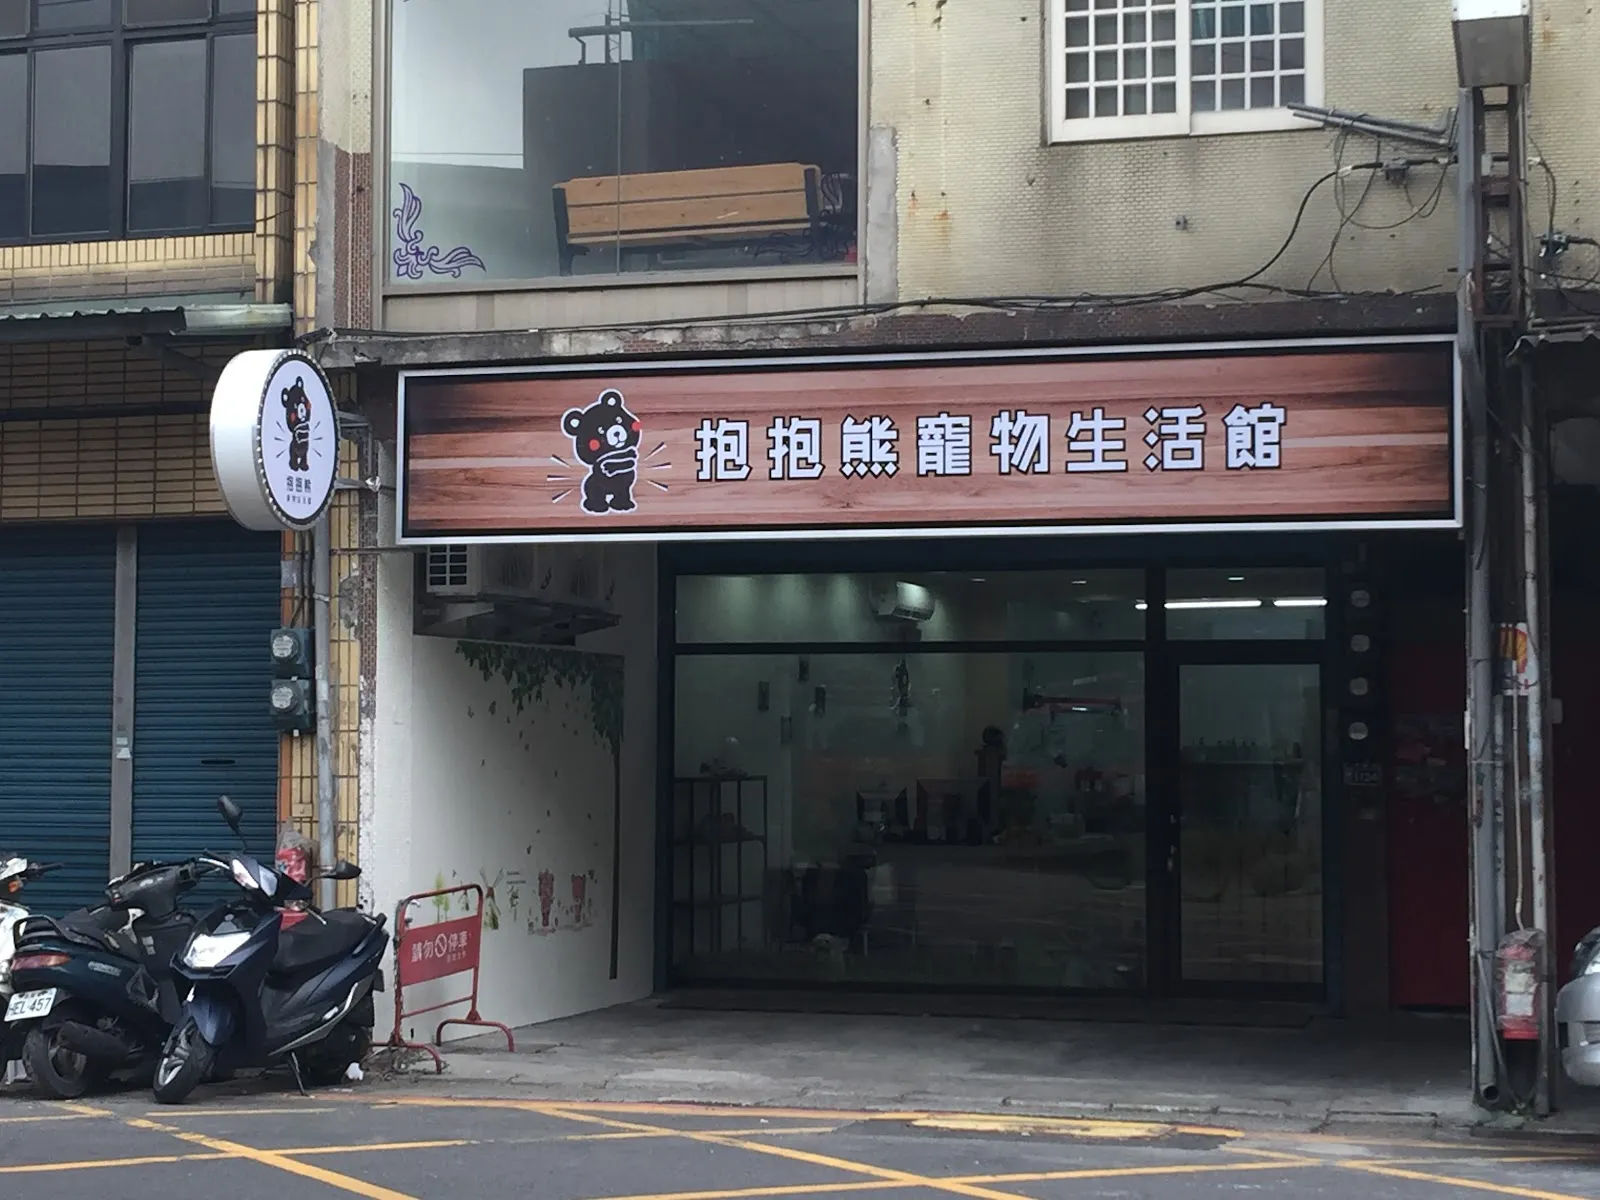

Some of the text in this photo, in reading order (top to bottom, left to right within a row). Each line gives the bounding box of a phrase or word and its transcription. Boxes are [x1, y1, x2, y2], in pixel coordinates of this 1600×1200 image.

[696, 402, 1287, 481] 抱抱熊寵物生活館
[411, 939, 434, 963] 請勿
[448, 930, 468, 953] 停車
